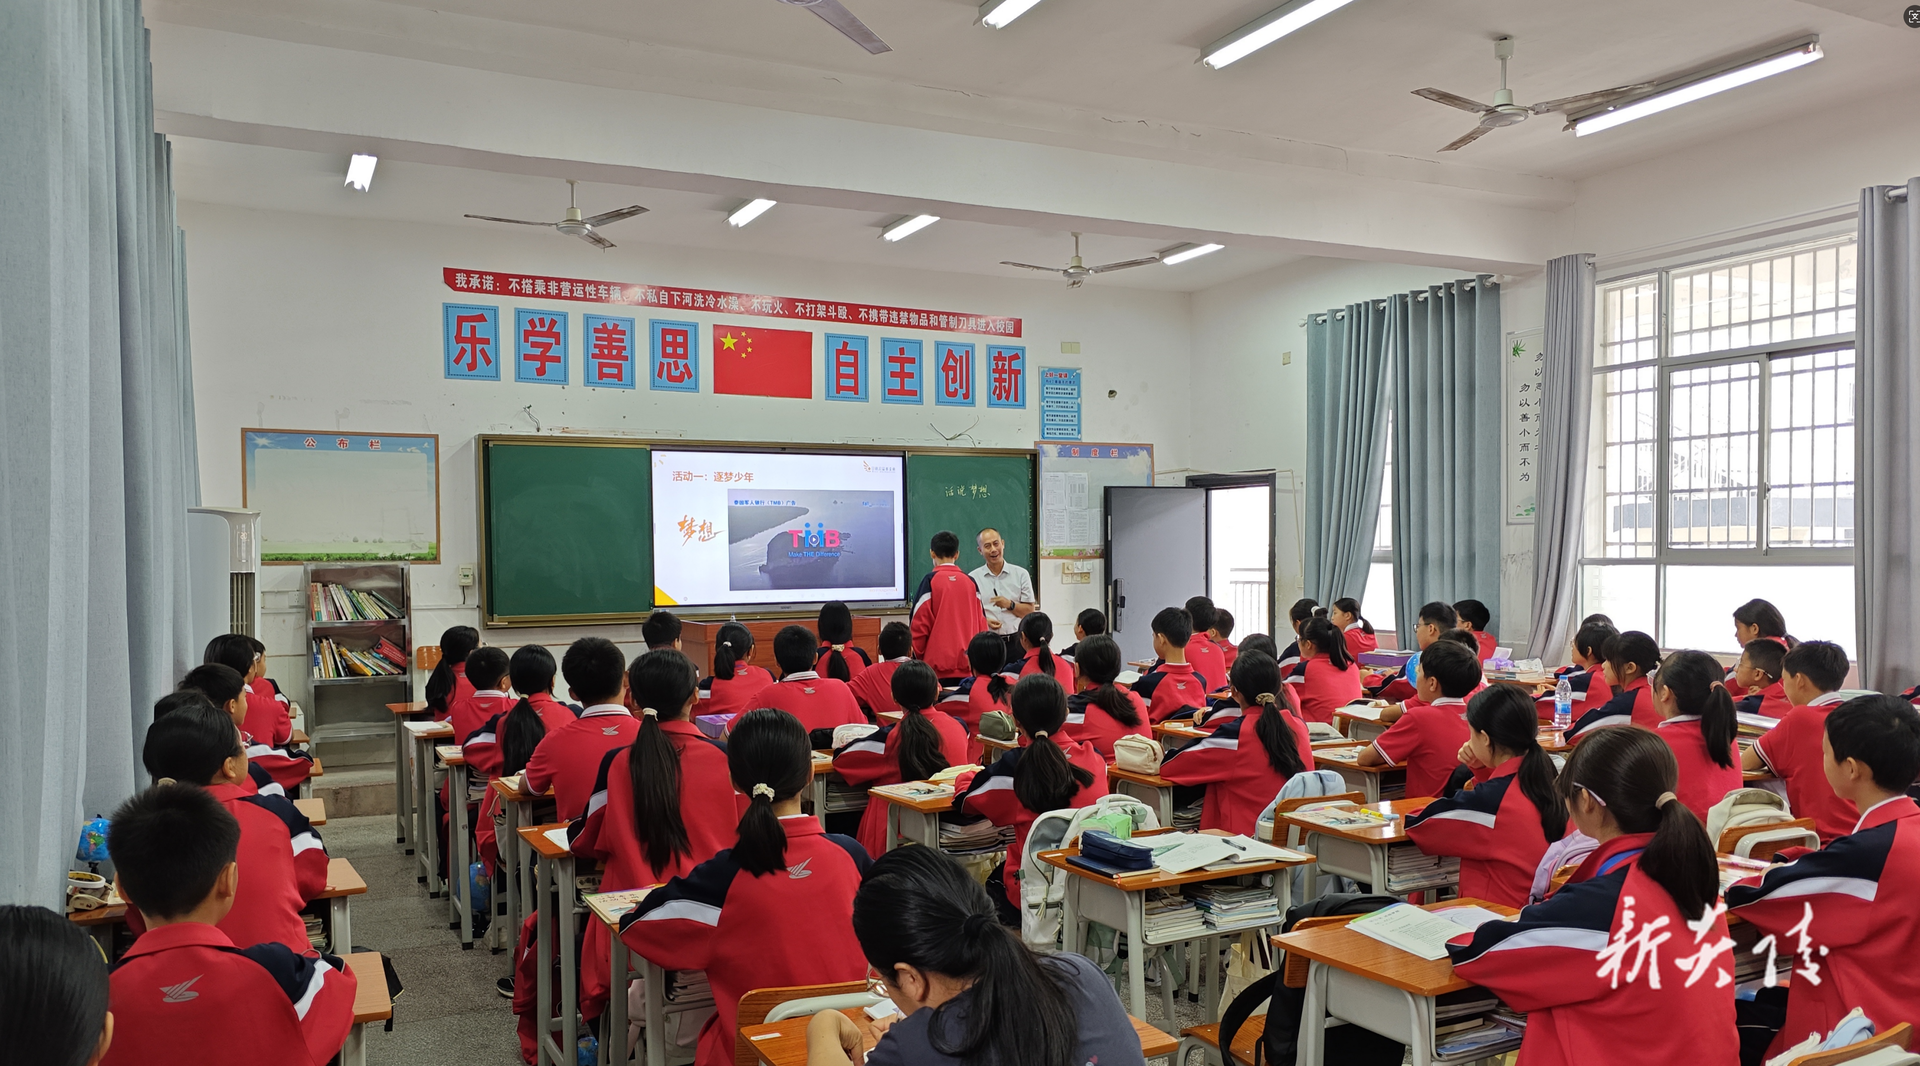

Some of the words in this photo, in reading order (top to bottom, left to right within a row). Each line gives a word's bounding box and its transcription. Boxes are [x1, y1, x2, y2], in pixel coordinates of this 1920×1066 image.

[454, 312, 693, 383] 乐学善思
[835, 341, 1022, 402] 自主创新
[303, 436, 382, 450] 公布栏
[1519, 383, 1531, 482] 勿以善小而不为
[1071, 447, 1119, 458] 制度栏
[672, 470, 754, 483] 活动一：逐梦少年
[945, 484, 991, 500] 话说梦想
[677, 514, 726, 546] 梦想
[788, 523, 841, 548] TMB
